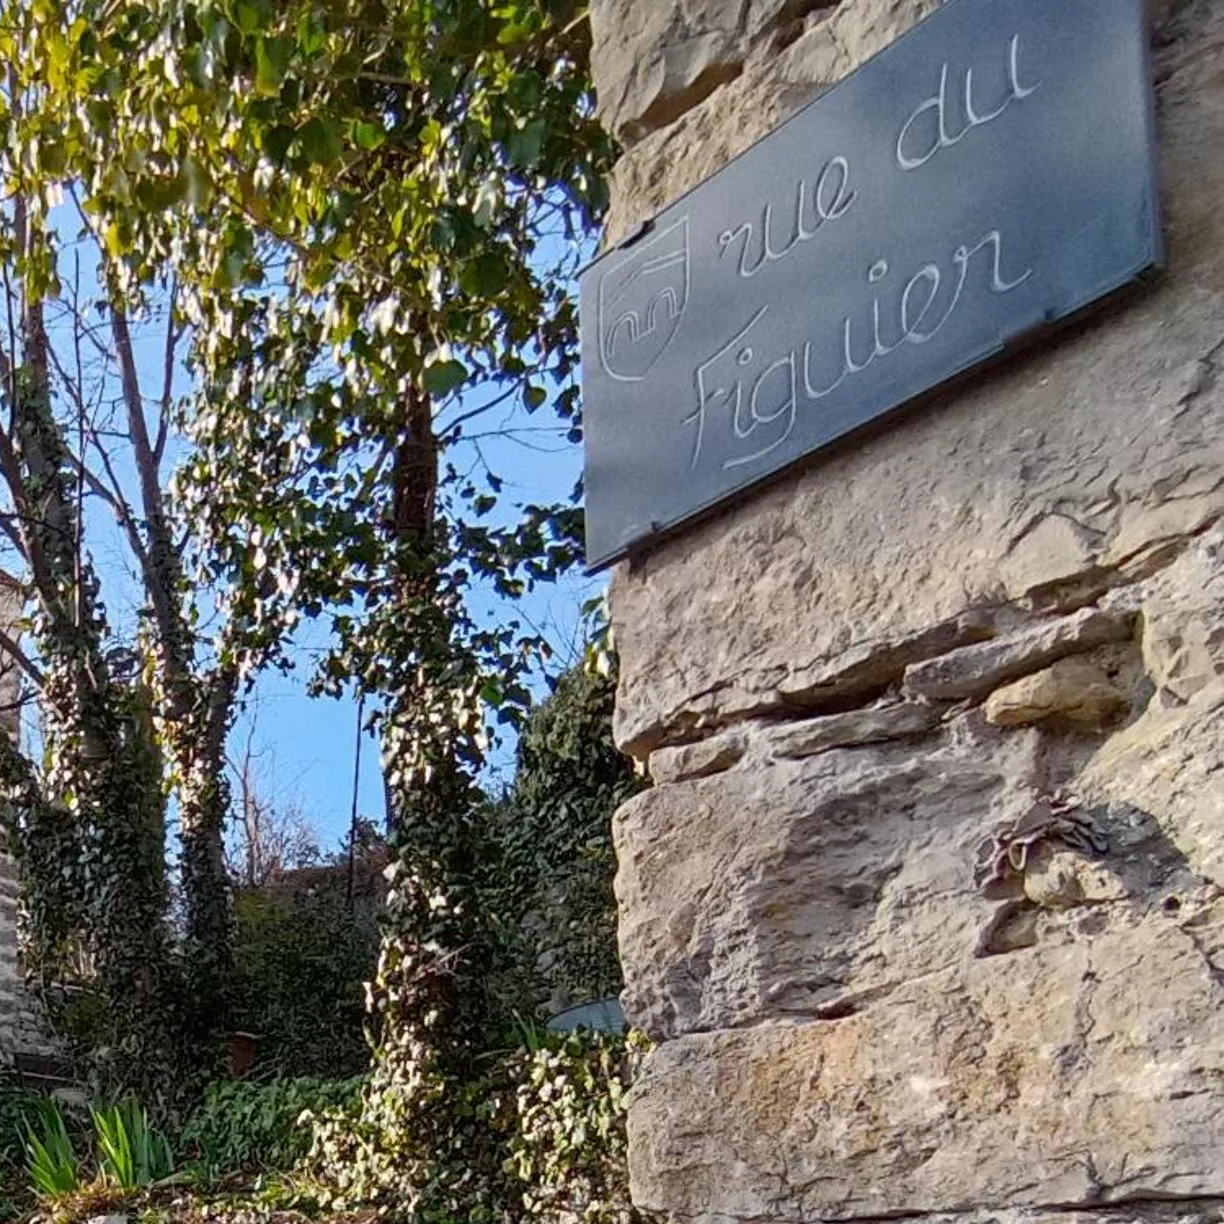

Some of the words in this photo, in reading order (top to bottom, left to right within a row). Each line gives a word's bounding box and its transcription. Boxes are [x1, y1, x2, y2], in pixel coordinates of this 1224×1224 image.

[719, 155, 858, 278] rue
[895, 33, 1043, 170] du
[683, 230, 1034, 471] Figuier
